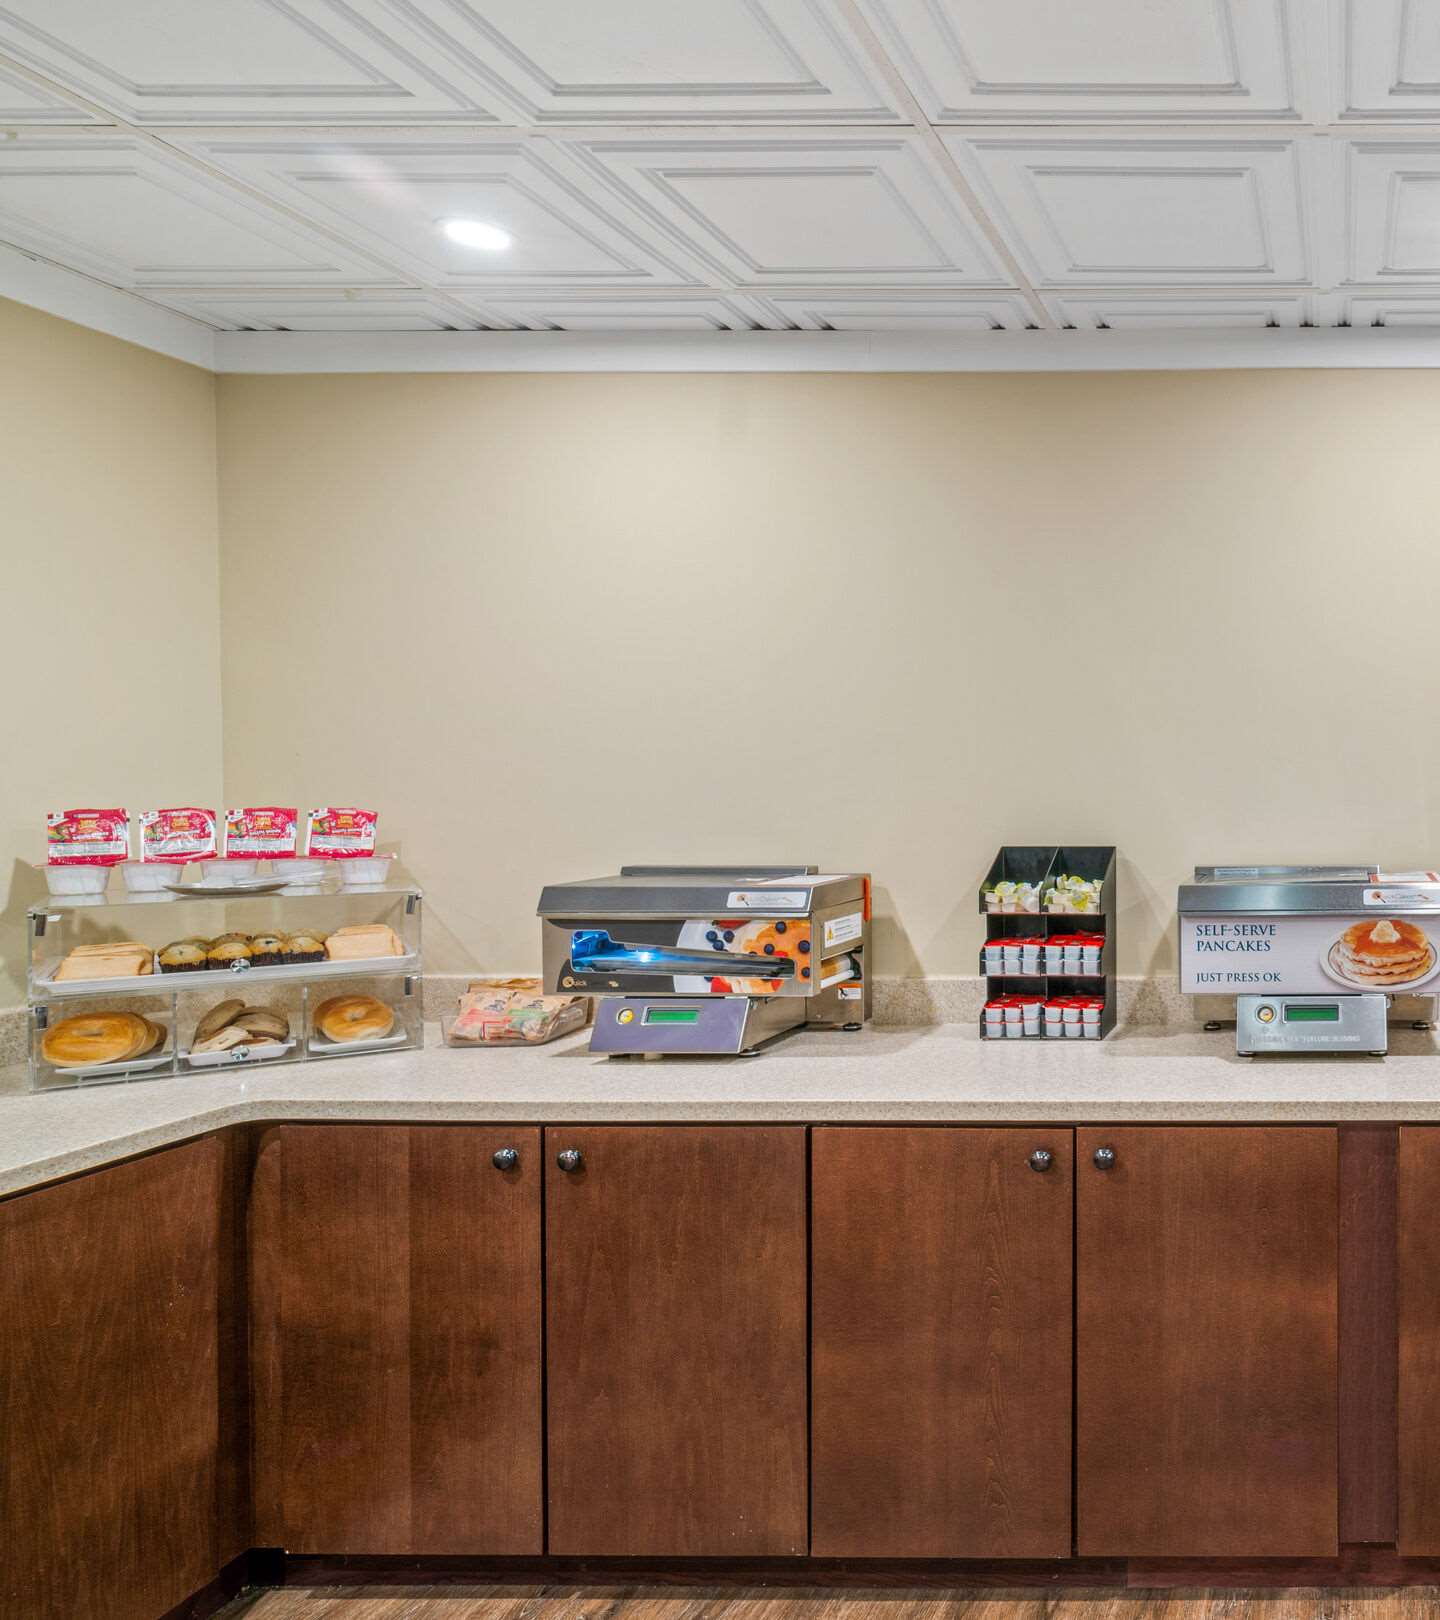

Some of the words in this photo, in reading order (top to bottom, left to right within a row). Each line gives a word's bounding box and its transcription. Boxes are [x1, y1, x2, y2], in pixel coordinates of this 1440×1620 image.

[1196, 924, 1277, 936] SELF-SERVE
[1196, 940, 1271, 952] PANCAKES
[1195, 971, 1224, 984] JUST
[1226, 971, 1260, 983] PRESS
[1262, 971, 1282, 983] OK
